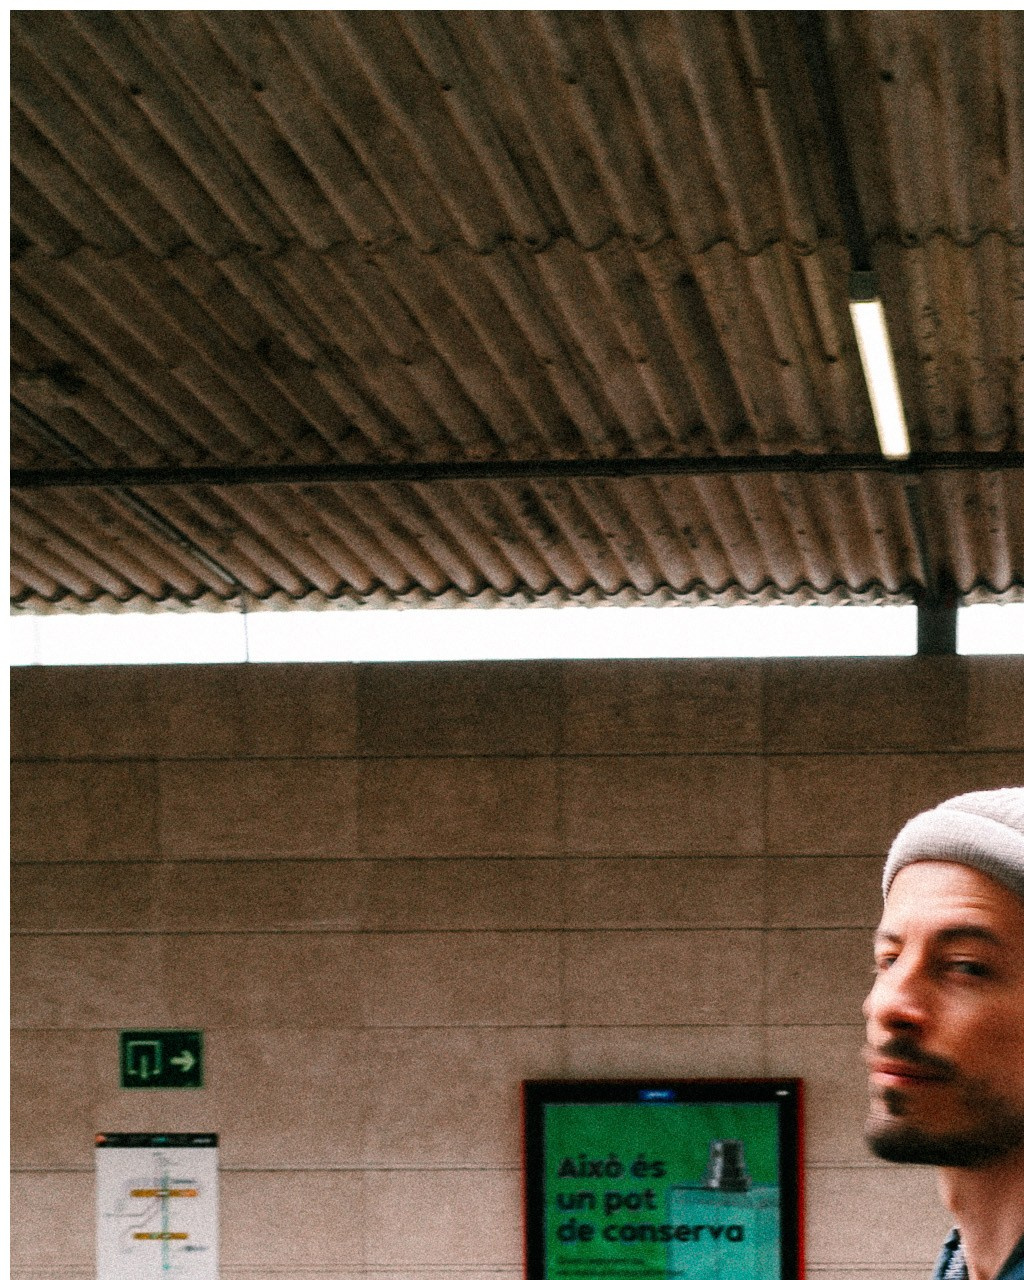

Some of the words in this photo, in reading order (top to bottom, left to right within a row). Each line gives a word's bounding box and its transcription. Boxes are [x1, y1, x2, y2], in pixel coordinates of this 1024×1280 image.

[558, 1153, 624, 1179] Això
[630, 1153, 666, 1179] és
[556, 1191, 595, 1211] un
[604, 1188, 658, 1217] pot
[556, 1217, 594, 1242] de
[601, 1222, 745, 1243] conserva
